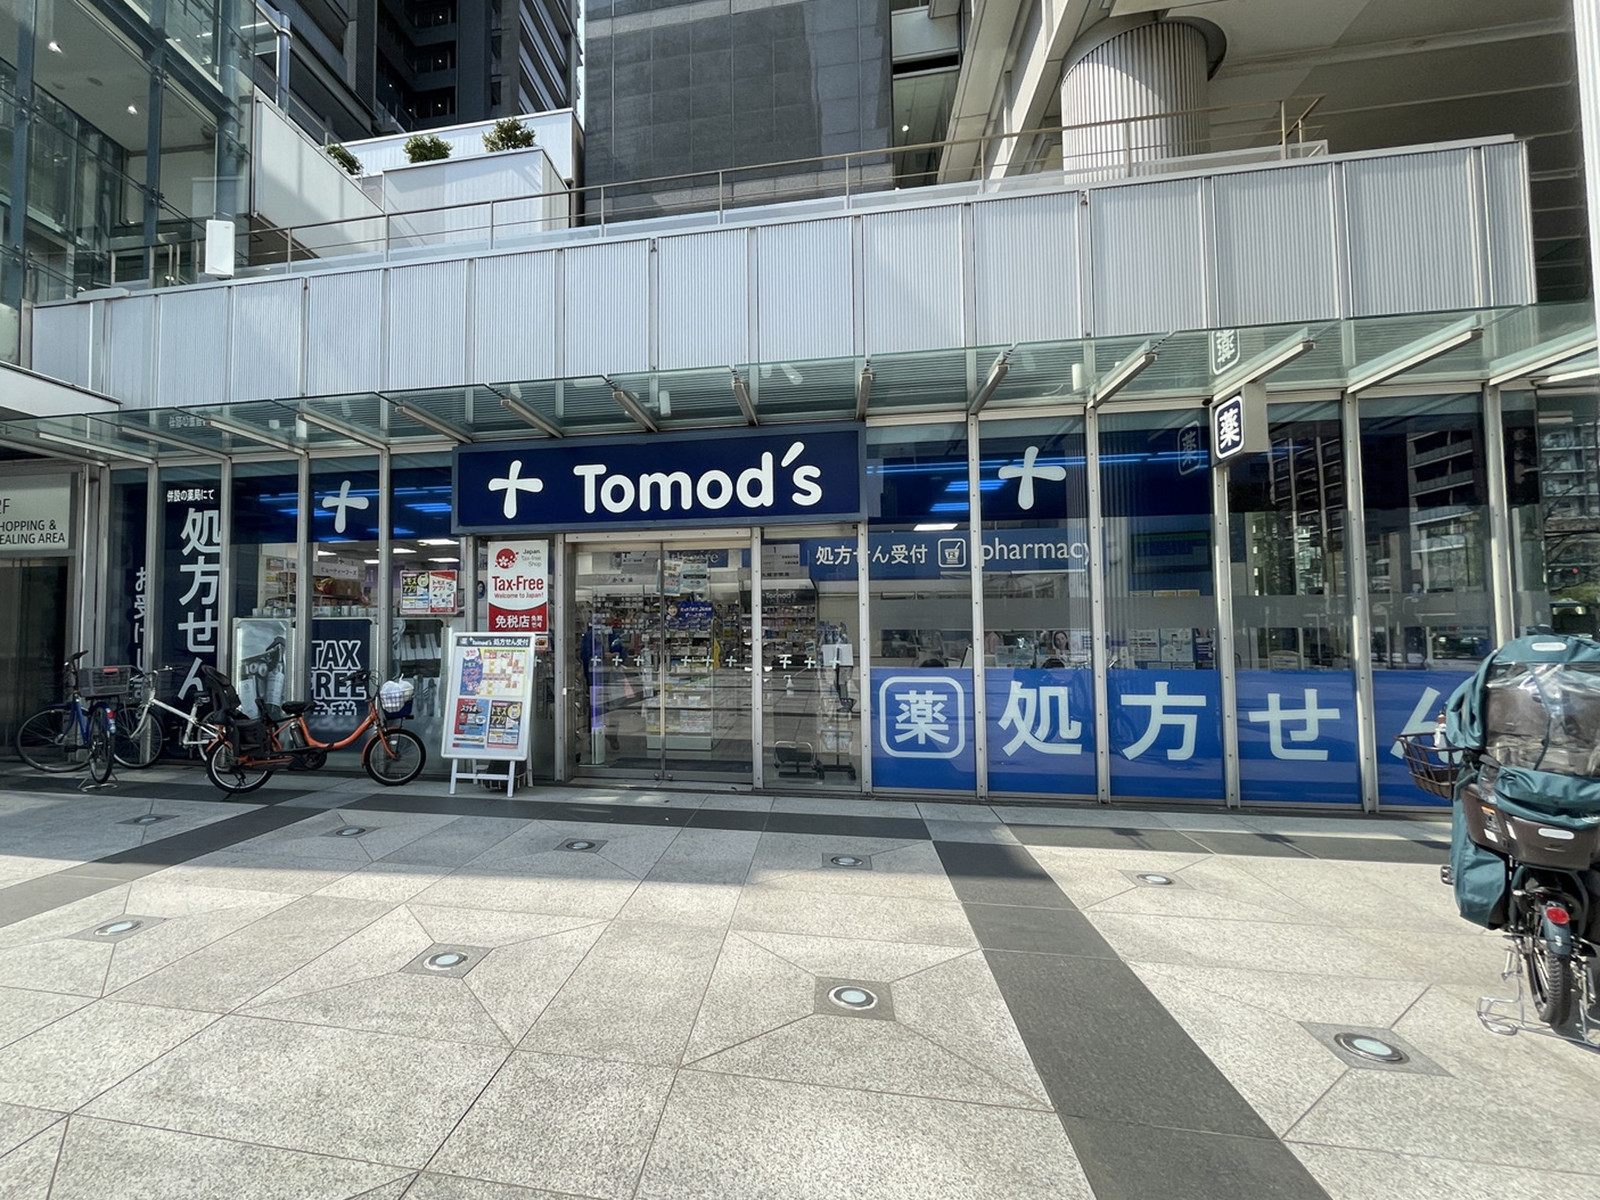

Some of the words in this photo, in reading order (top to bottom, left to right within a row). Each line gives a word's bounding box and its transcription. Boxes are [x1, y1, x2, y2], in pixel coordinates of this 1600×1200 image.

[1219, 408, 1240, 449] 薬
[573, 440, 823, 515] Tomod's
[37, 532, 66, 544] AREA
[49, 519, 57, 531] &
[492, 575, 544, 591] Tax-Free
[495, 614, 530, 629] 免税店
[311, 640, 361, 669] TAX
[311, 670, 366, 700] REE
[894, 689, 951, 745] 薬
